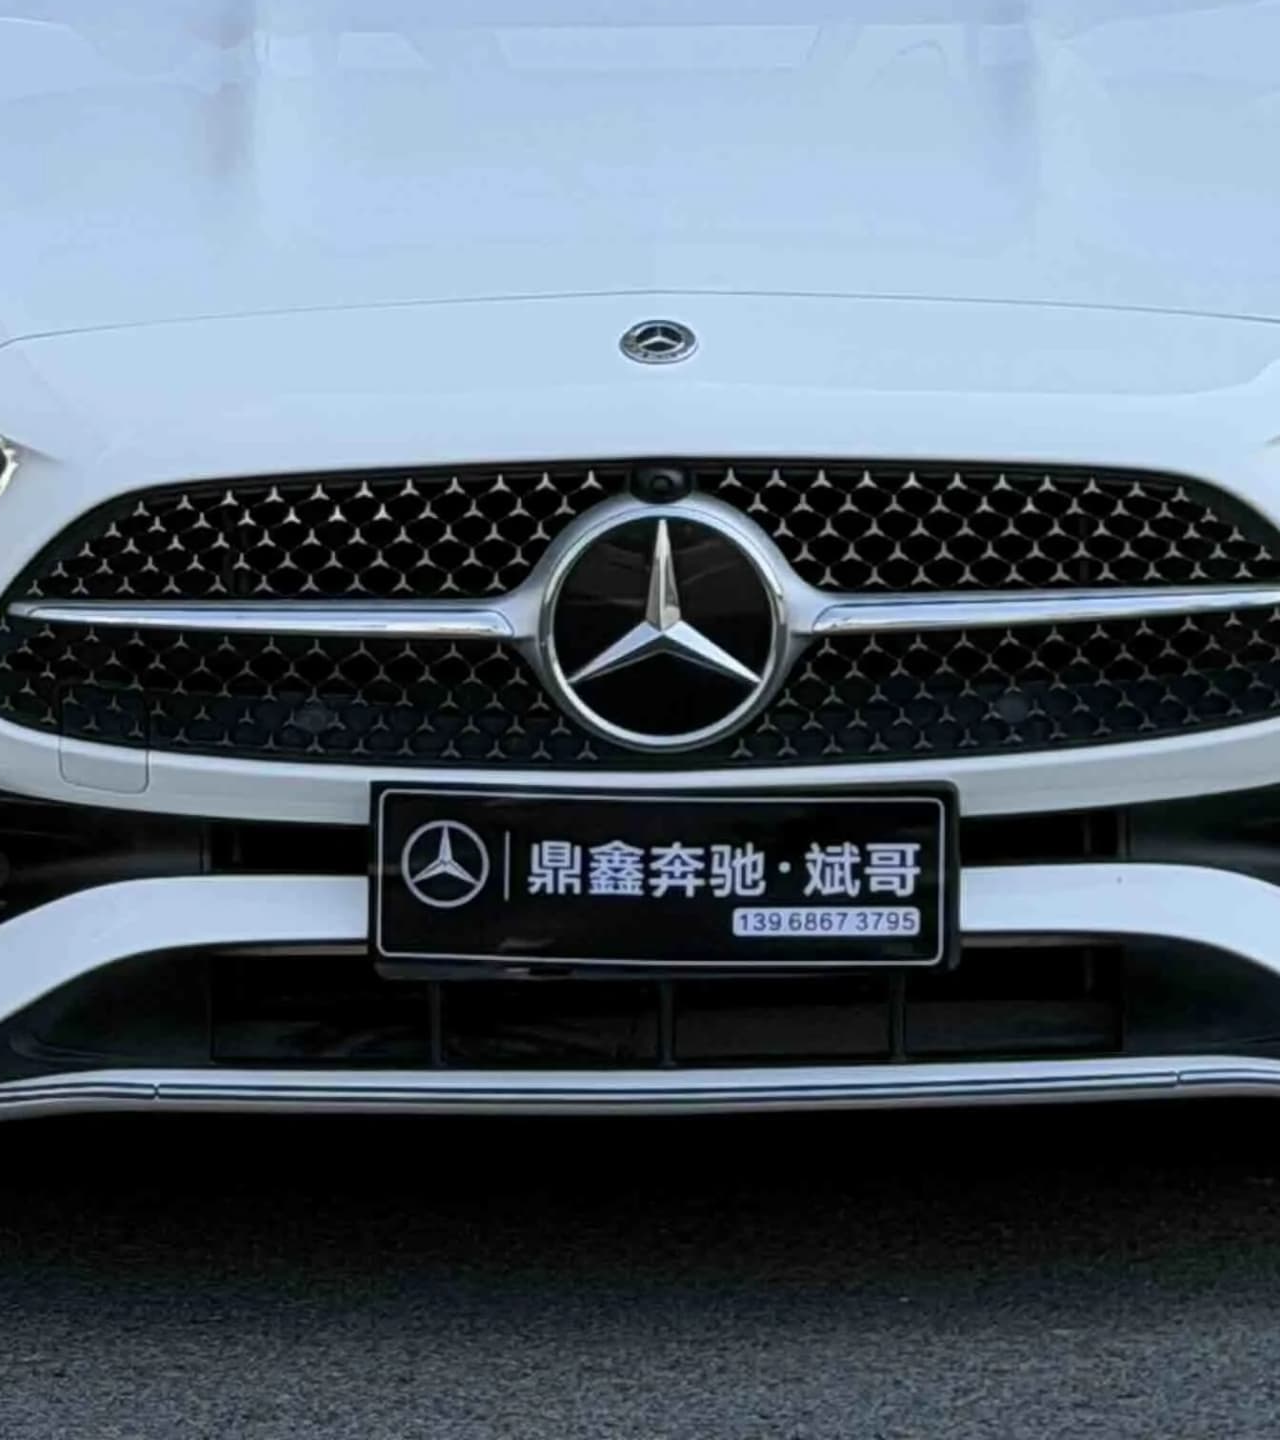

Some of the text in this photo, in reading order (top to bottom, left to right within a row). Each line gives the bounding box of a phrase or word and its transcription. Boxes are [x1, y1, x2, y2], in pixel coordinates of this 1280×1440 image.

[528, 841, 920, 896] 鼎鑫奔驰·斌哥
